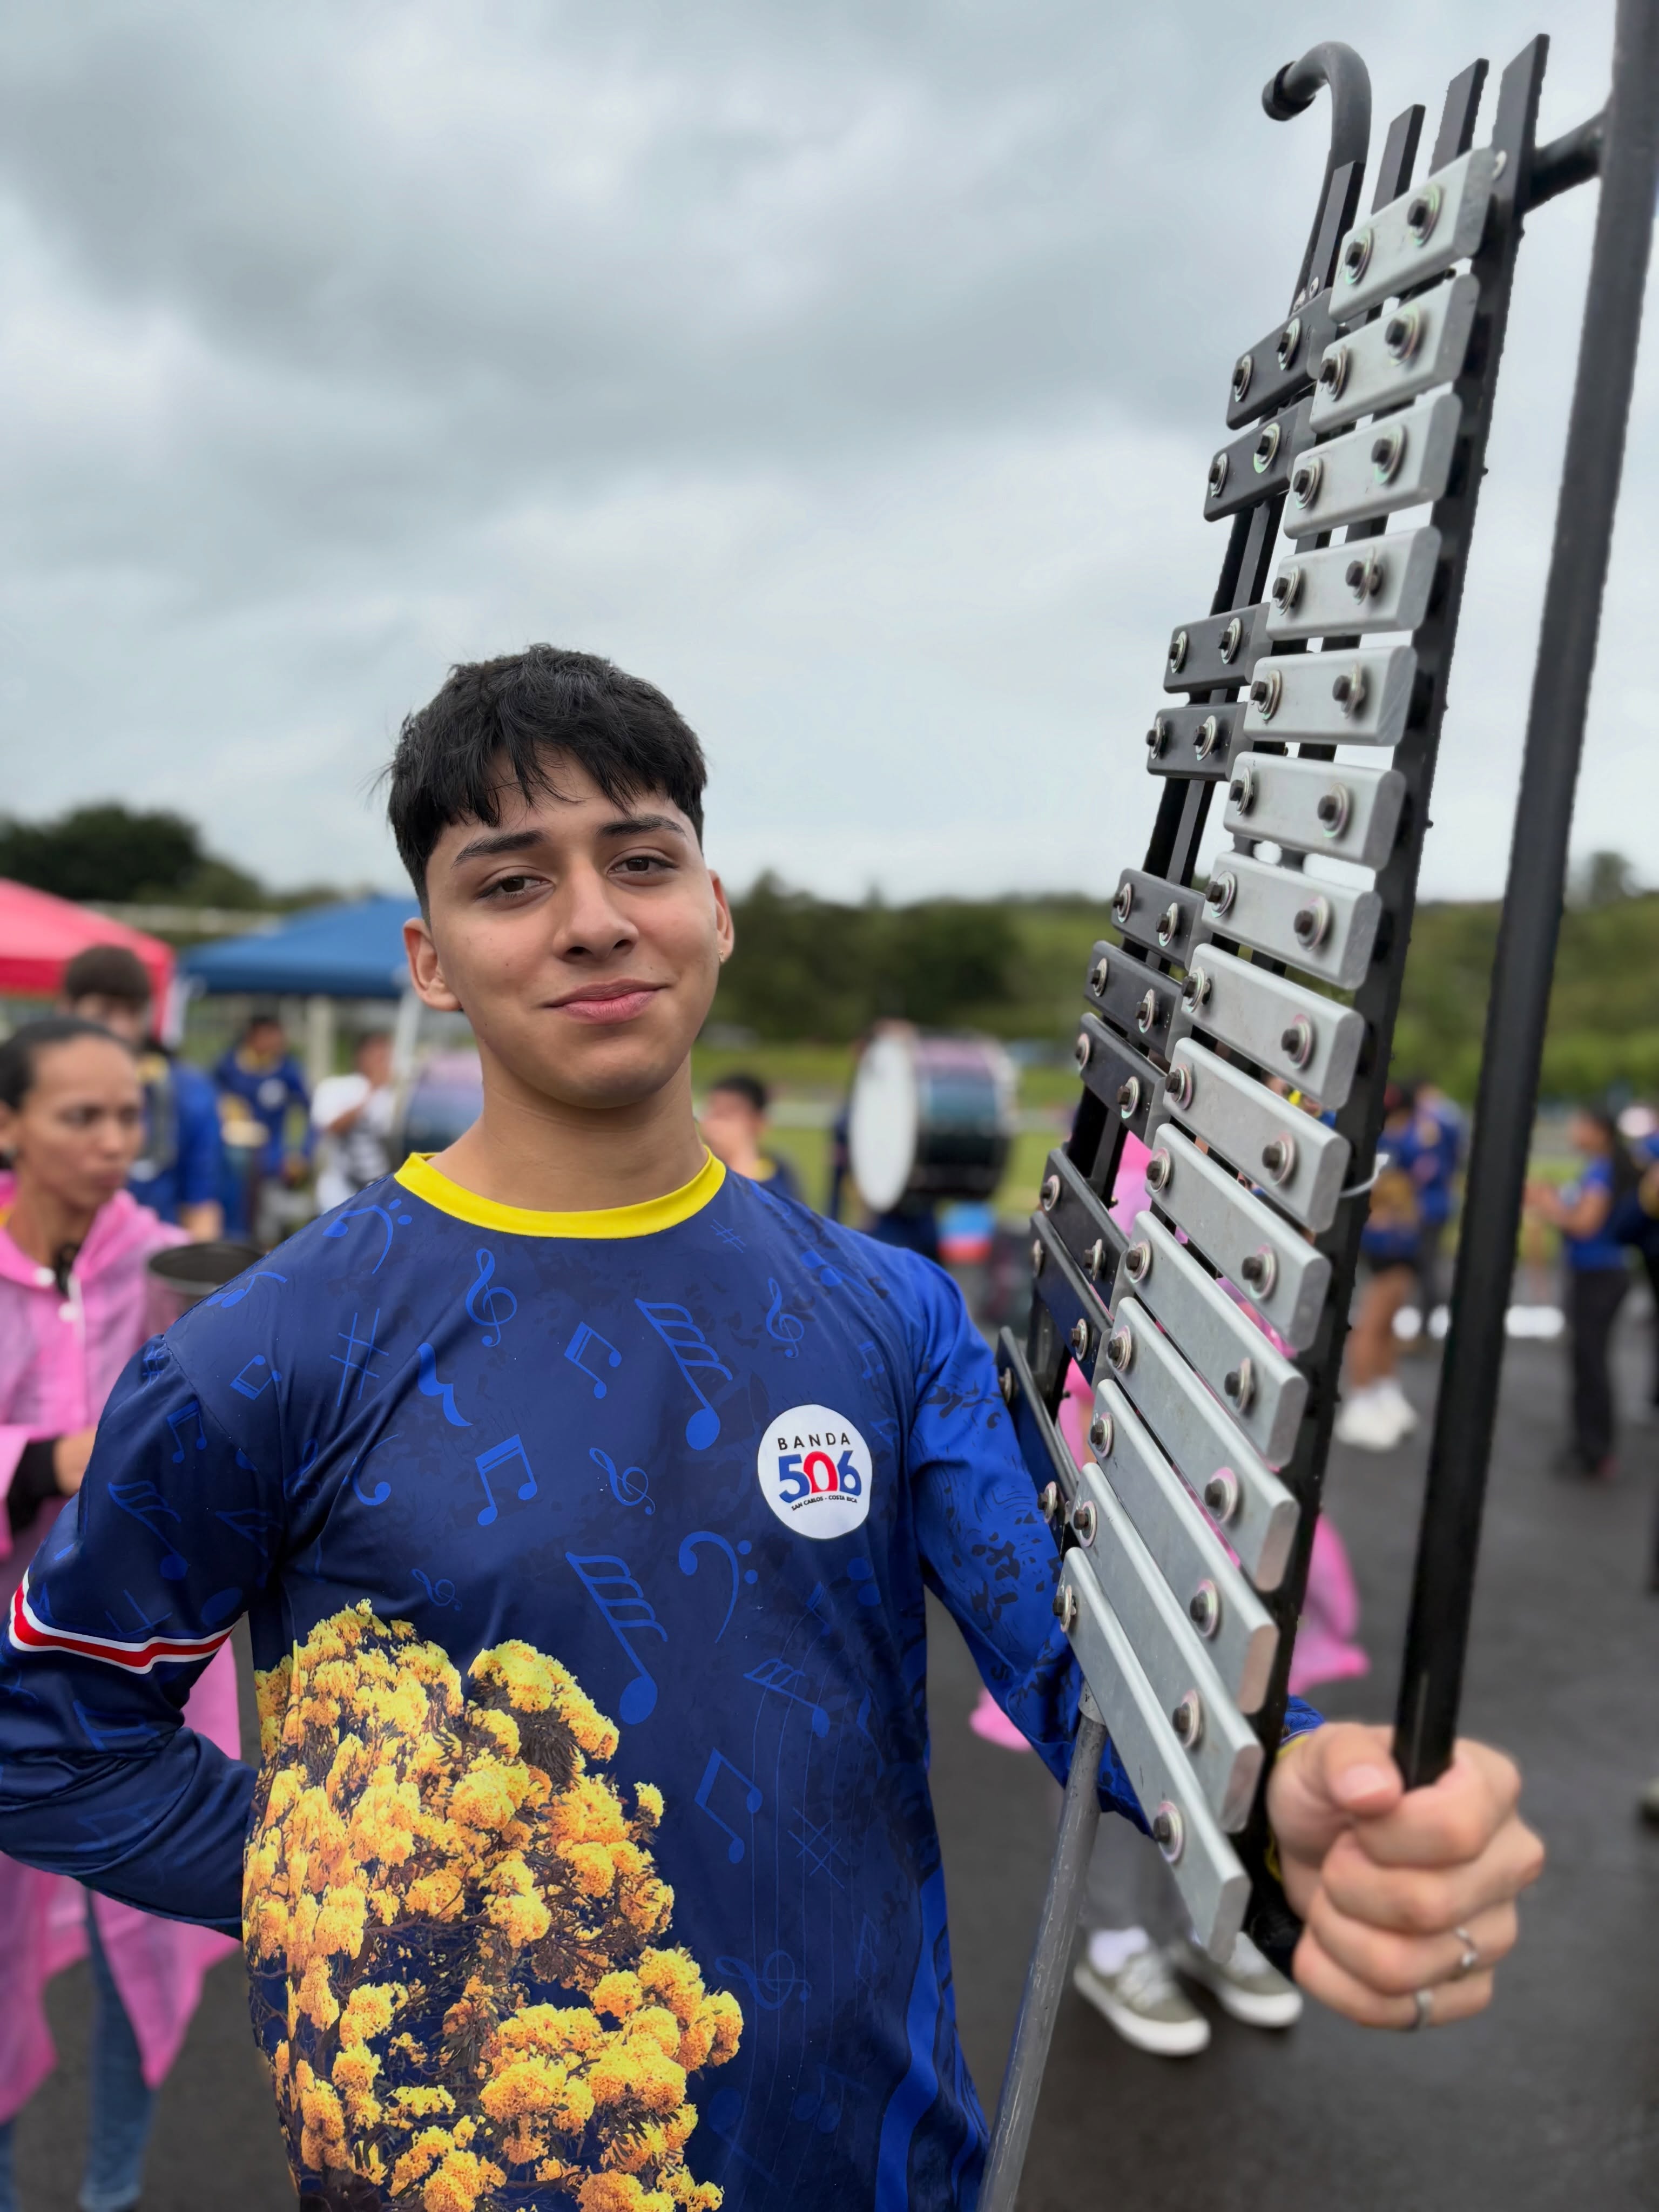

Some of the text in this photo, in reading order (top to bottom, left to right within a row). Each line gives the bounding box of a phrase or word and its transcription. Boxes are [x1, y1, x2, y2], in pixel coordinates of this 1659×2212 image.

[778, 1433, 851, 1450] BANDA
[778, 1450, 862, 1503] 506
[791, 1502, 803, 1511] SAN
[804, 1496, 824, 1505] CARLOS
